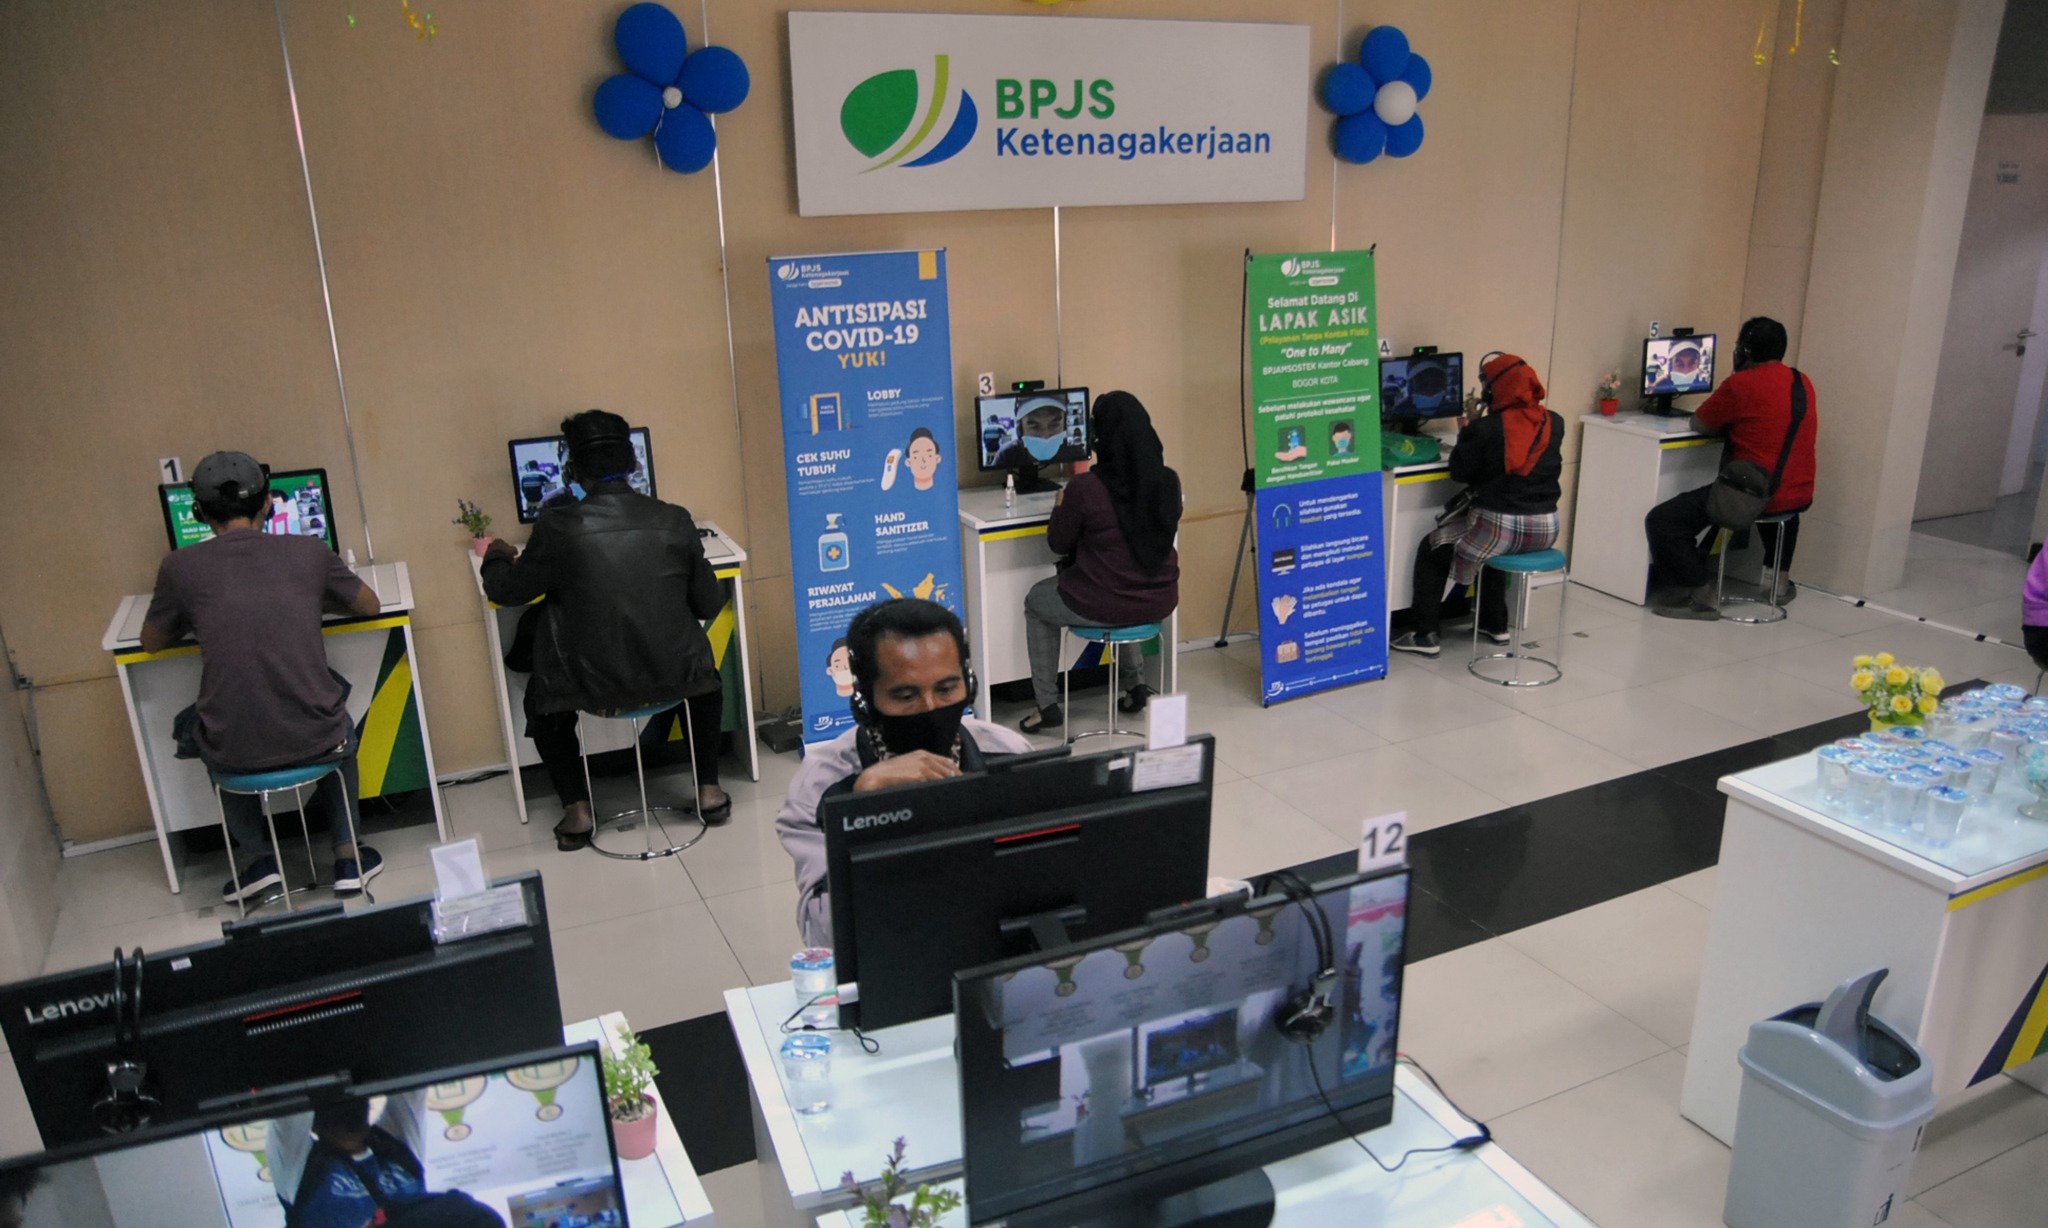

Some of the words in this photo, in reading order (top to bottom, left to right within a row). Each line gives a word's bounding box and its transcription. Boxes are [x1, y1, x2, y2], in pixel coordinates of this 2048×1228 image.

[995, 78, 1116, 120] BPJS
[996, 125, 1271, 160] Ketenagakerjaan
[1267, 296, 1308, 308] Selamat
[1310, 294, 1346, 306] Datang
[1347, 291, 1359, 303] Di
[794, 299, 927, 328] ANTISIPASI
[1259, 310, 1319, 332] LAPAK
[1327, 307, 1368, 327] ASIK
[805, 323, 919, 351] COVID-19
[1650, 322, 1659, 337] 5
[1308, 345, 1318, 356] to
[1380, 340, 1390, 355] 4
[837, 350, 886, 369] YUK!
[1262, 360, 1317, 376] BPJAMSOSTEK
[1318, 359, 1341, 370] Kantor
[1342, 357, 1369, 368] Cabang
[980, 375, 992, 395] 3
[1292, 377, 1319, 389] BOGOR
[1320, 375, 1339, 385] KOTA
[867, 388, 902, 401] LOBBY
[1258, 403, 1287, 414] Sebelum
[796, 452, 818, 465] CEK
[820, 449, 851, 461] SUHU
[163, 459, 178, 482] 1
[797, 463, 837, 477] TUBUH
[874, 511, 906, 524] HAND
[875, 521, 929, 537] SANITIZER
[807, 582, 854, 597] RIWAYAT
[808, 591, 877, 609] PERJALANAN
[842, 806, 914, 832] Lenovo
[1362, 821, 1405, 860] 12
